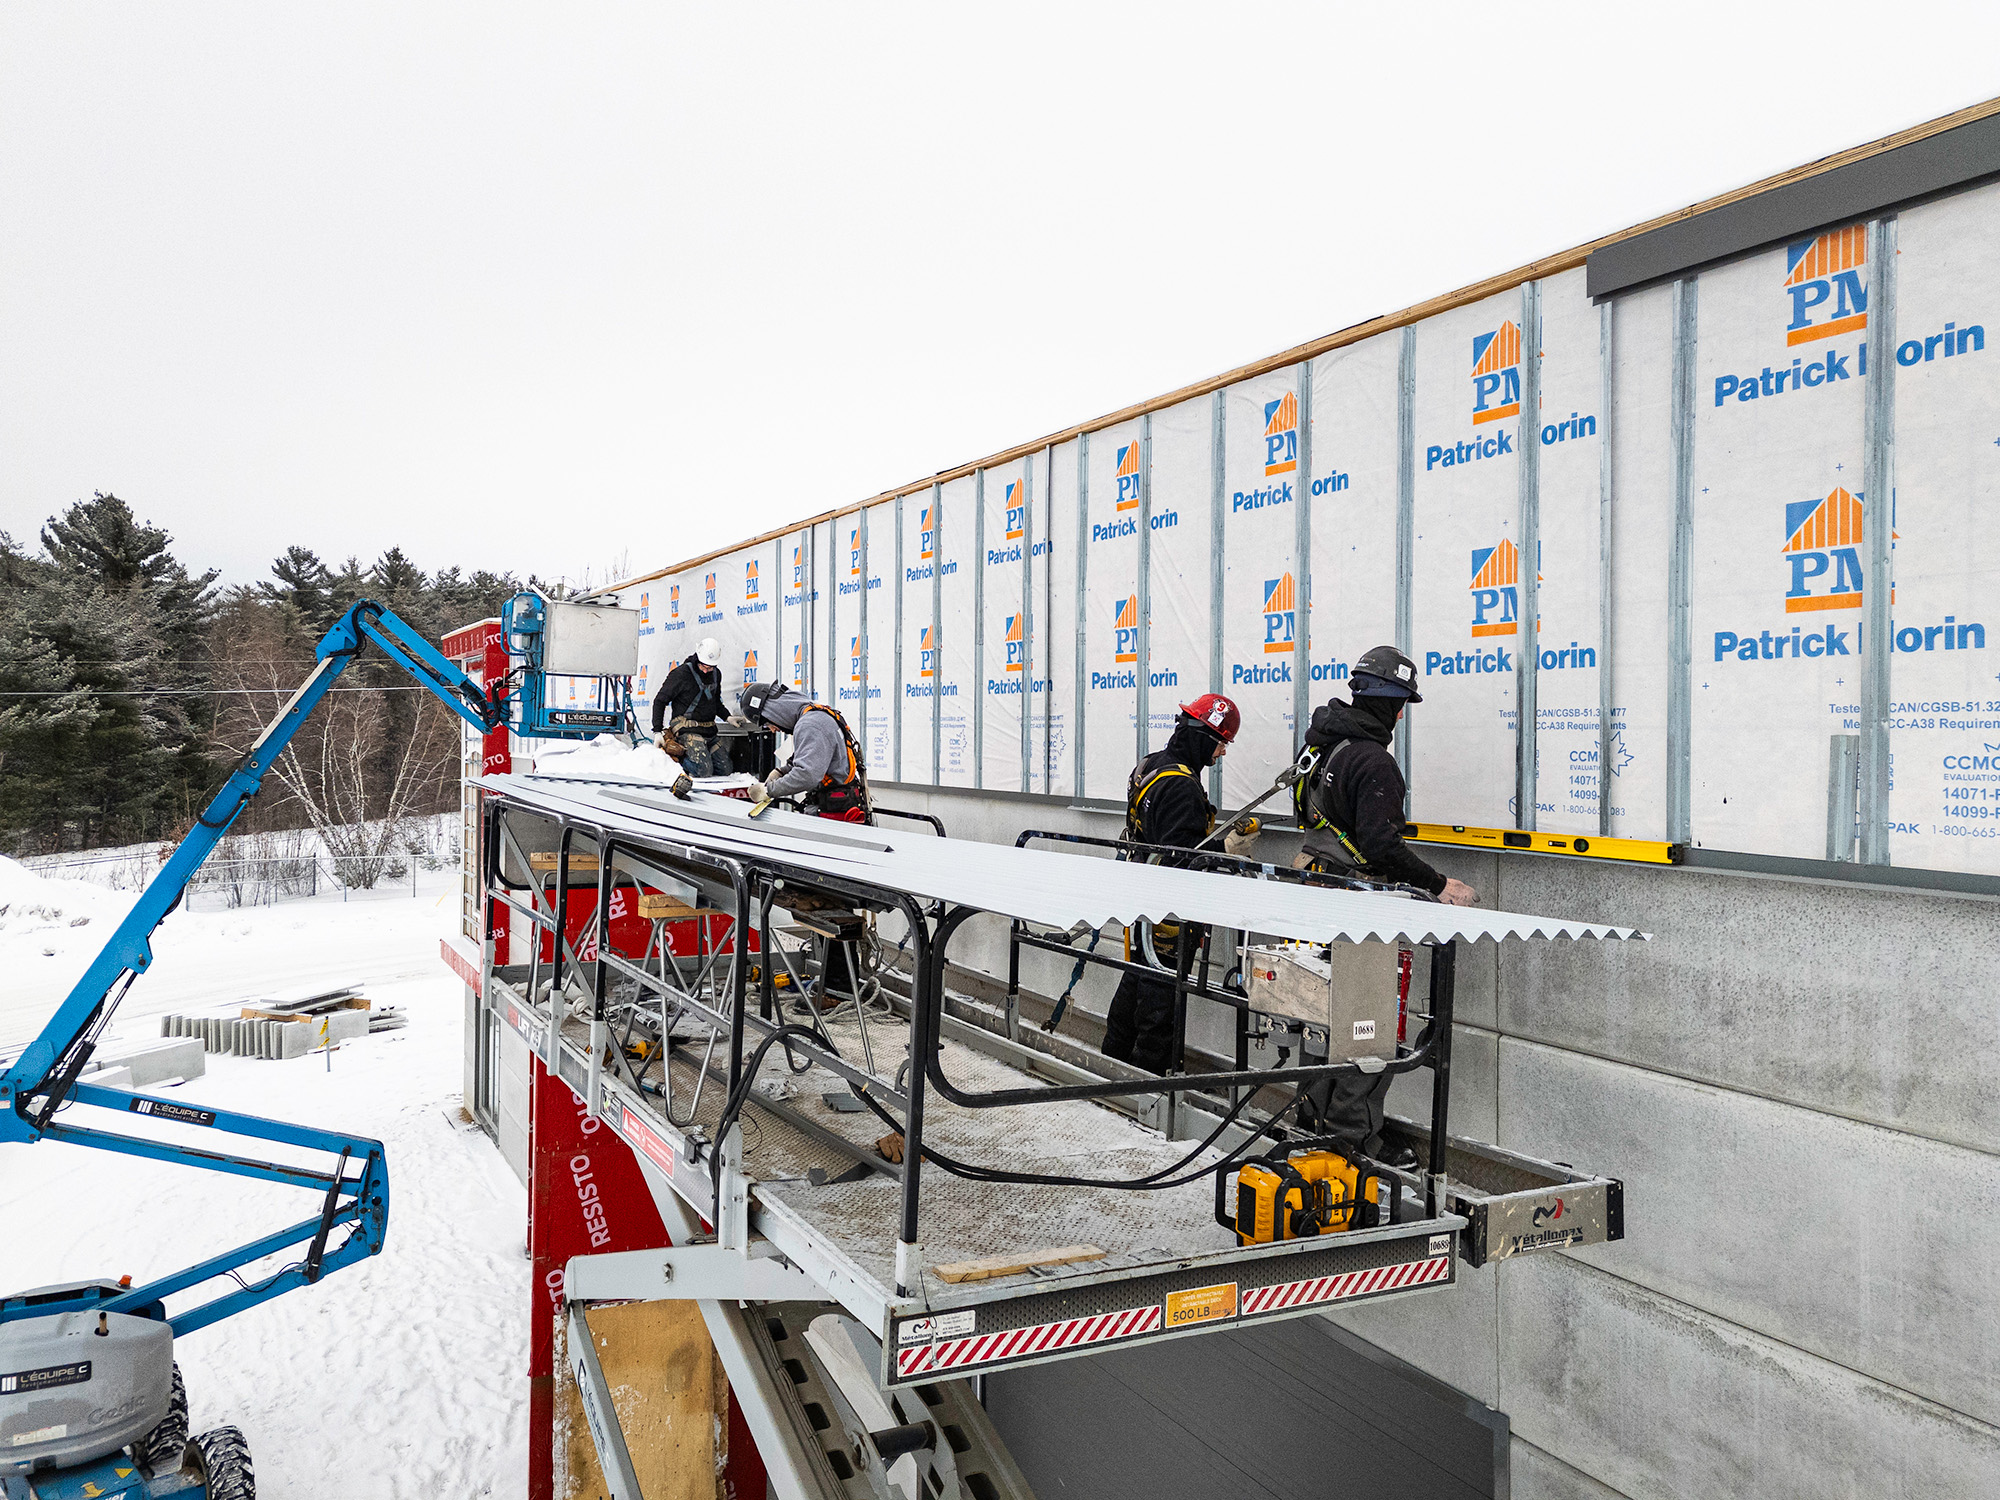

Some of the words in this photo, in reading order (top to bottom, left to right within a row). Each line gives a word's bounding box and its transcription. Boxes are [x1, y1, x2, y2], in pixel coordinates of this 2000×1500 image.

[1715, 350, 1850, 407] Patrick
[1858, 322, 1984, 376] orin
[1427, 430, 1512, 471] Patrick
[1539, 412, 1596, 450] orin
[1233, 482, 1293, 513] Patrick
[1311, 470, 1349, 497] orin
[1093, 516, 1137, 542] Patrick
[1151, 508, 1178, 530] orin
[988, 544, 1022, 566] Patrick
[906, 564, 933, 582] Patrick
[746, 577, 758, 594] PM
[1714, 624, 1850, 662] Patrick
[1858, 616, 1985, 655] orin
[1426, 646, 1512, 676] Patrick
[1537, 641, 1596, 670] orin
[1092, 670, 1136, 689] Patrick
[1148, 668, 1178, 687] orin
[1232, 661, 1292, 684] Patrick
[1308, 657, 1348, 681] orin
[906, 682, 933, 697] Patrick
[987, 677, 1022, 694] Patrick
[1569, 750, 1600, 762] CCM
[1354, 1024, 1374, 1036] 10688
[154, 1104, 198, 1118] L'ÉQUIPE
[200, 1112, 209, 1120] C
[569, 1154, 611, 1248] RESISTO
[1173, 1308, 1194, 1322] 500
[1197, 1306, 1210, 1318] LB
[20, 1367, 75, 1383] L'ÉQUIPE
[78, 1365, 88, 1374] C
